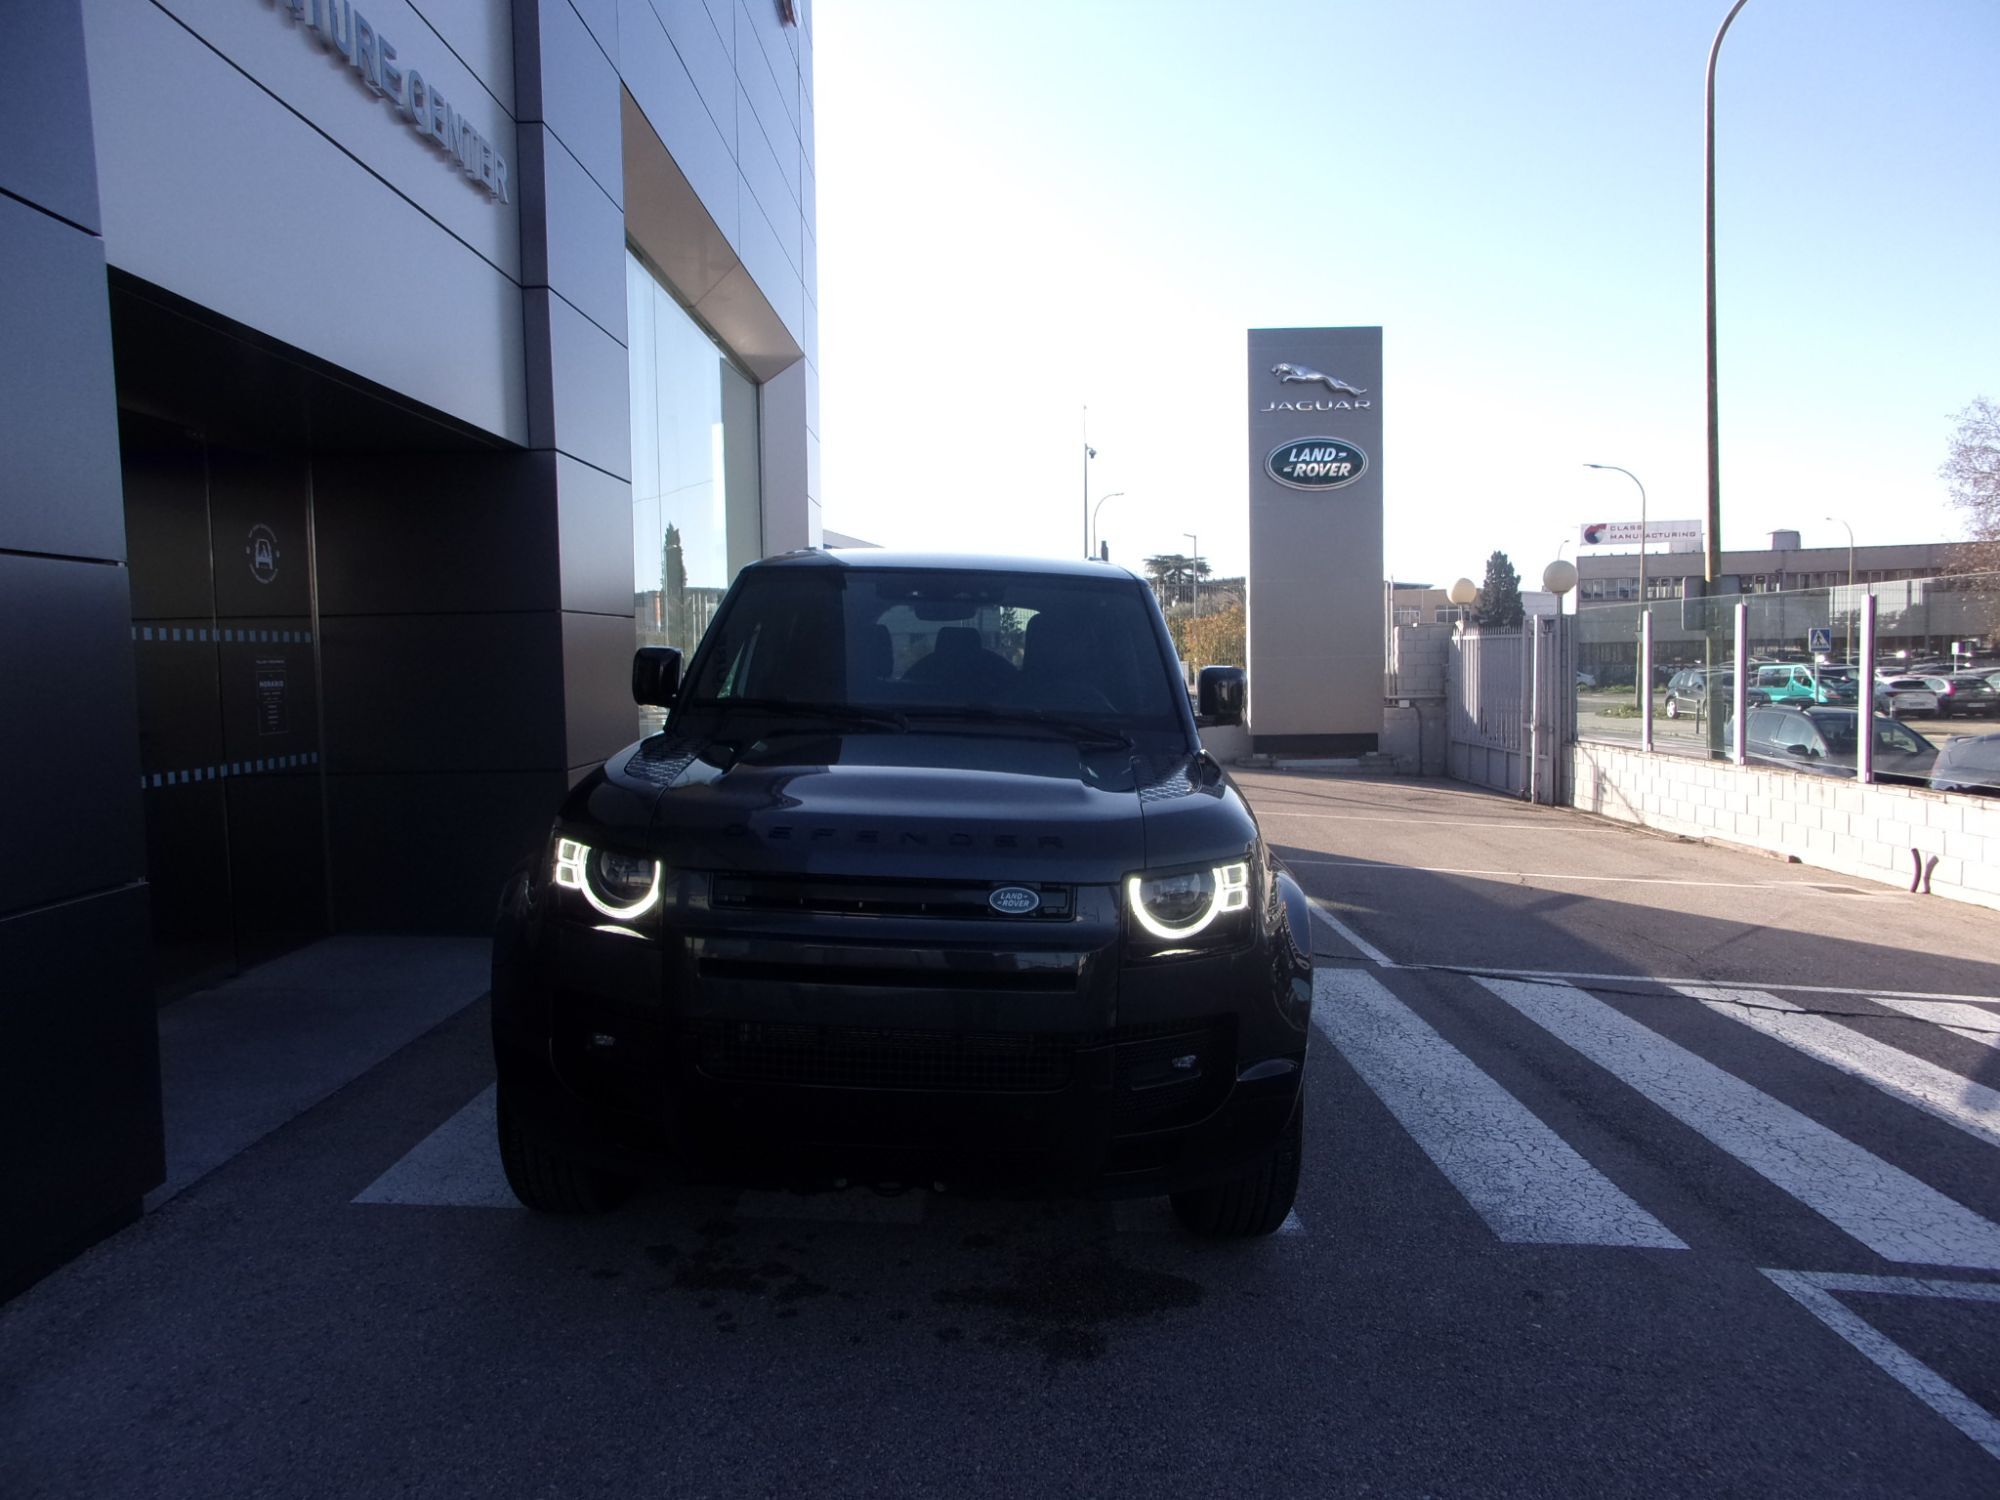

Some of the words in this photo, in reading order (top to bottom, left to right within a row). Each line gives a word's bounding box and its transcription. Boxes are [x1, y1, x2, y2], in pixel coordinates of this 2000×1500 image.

[402, 69, 510, 204] CENTER
[1260, 400, 1371, 412] JAGUAR
[1289, 448, 1337, 462] LAND
[1293, 463, 1352, 477] ROVER
[724, 825, 1064, 848] DEFENDER
[998, 892, 1024, 900] LAND
